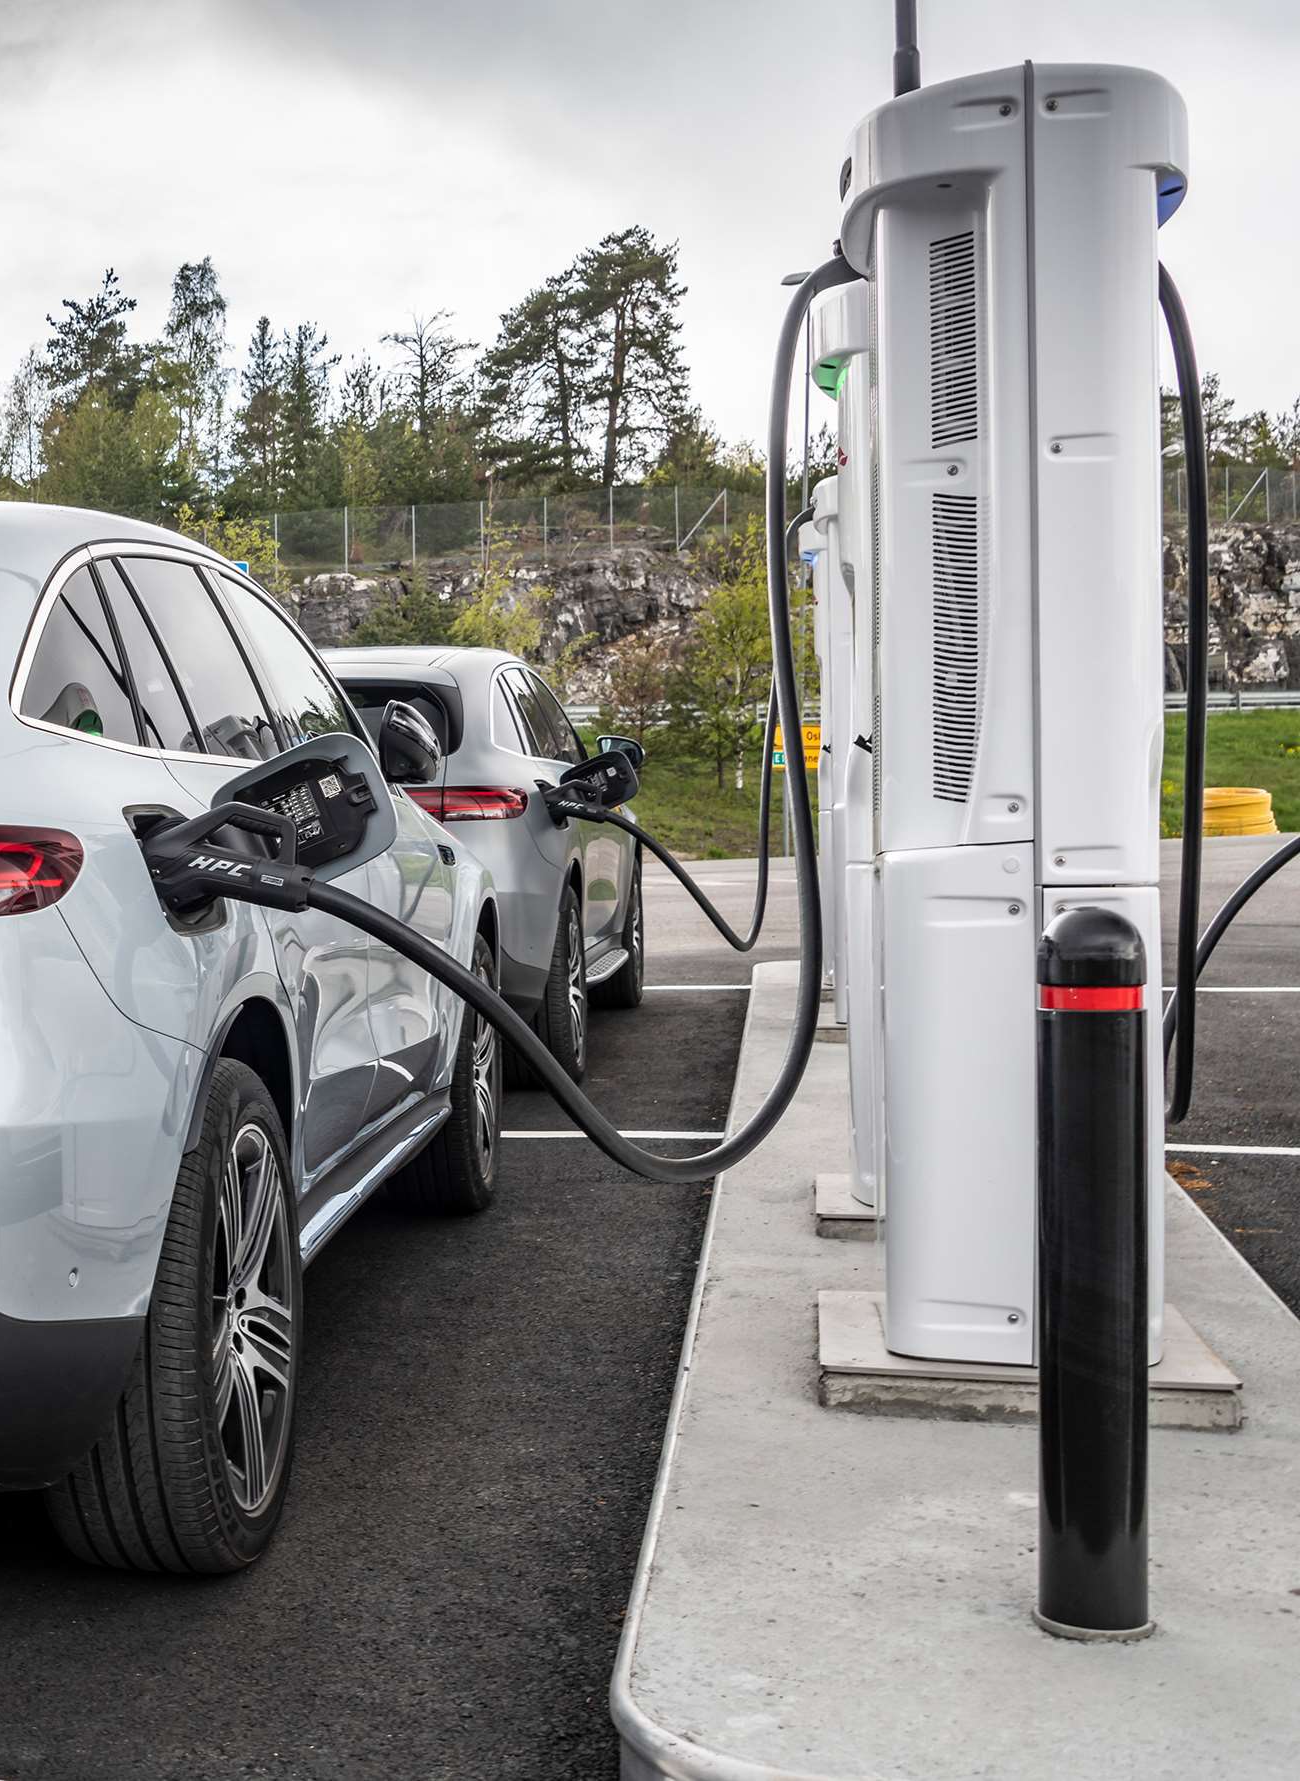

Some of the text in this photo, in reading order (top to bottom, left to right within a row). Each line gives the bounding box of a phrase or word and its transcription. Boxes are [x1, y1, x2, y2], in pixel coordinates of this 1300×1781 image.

[806, 731, 821, 740] Osl
[558, 800, 584, 810] HPC
[187, 855, 253, 877] HPC
